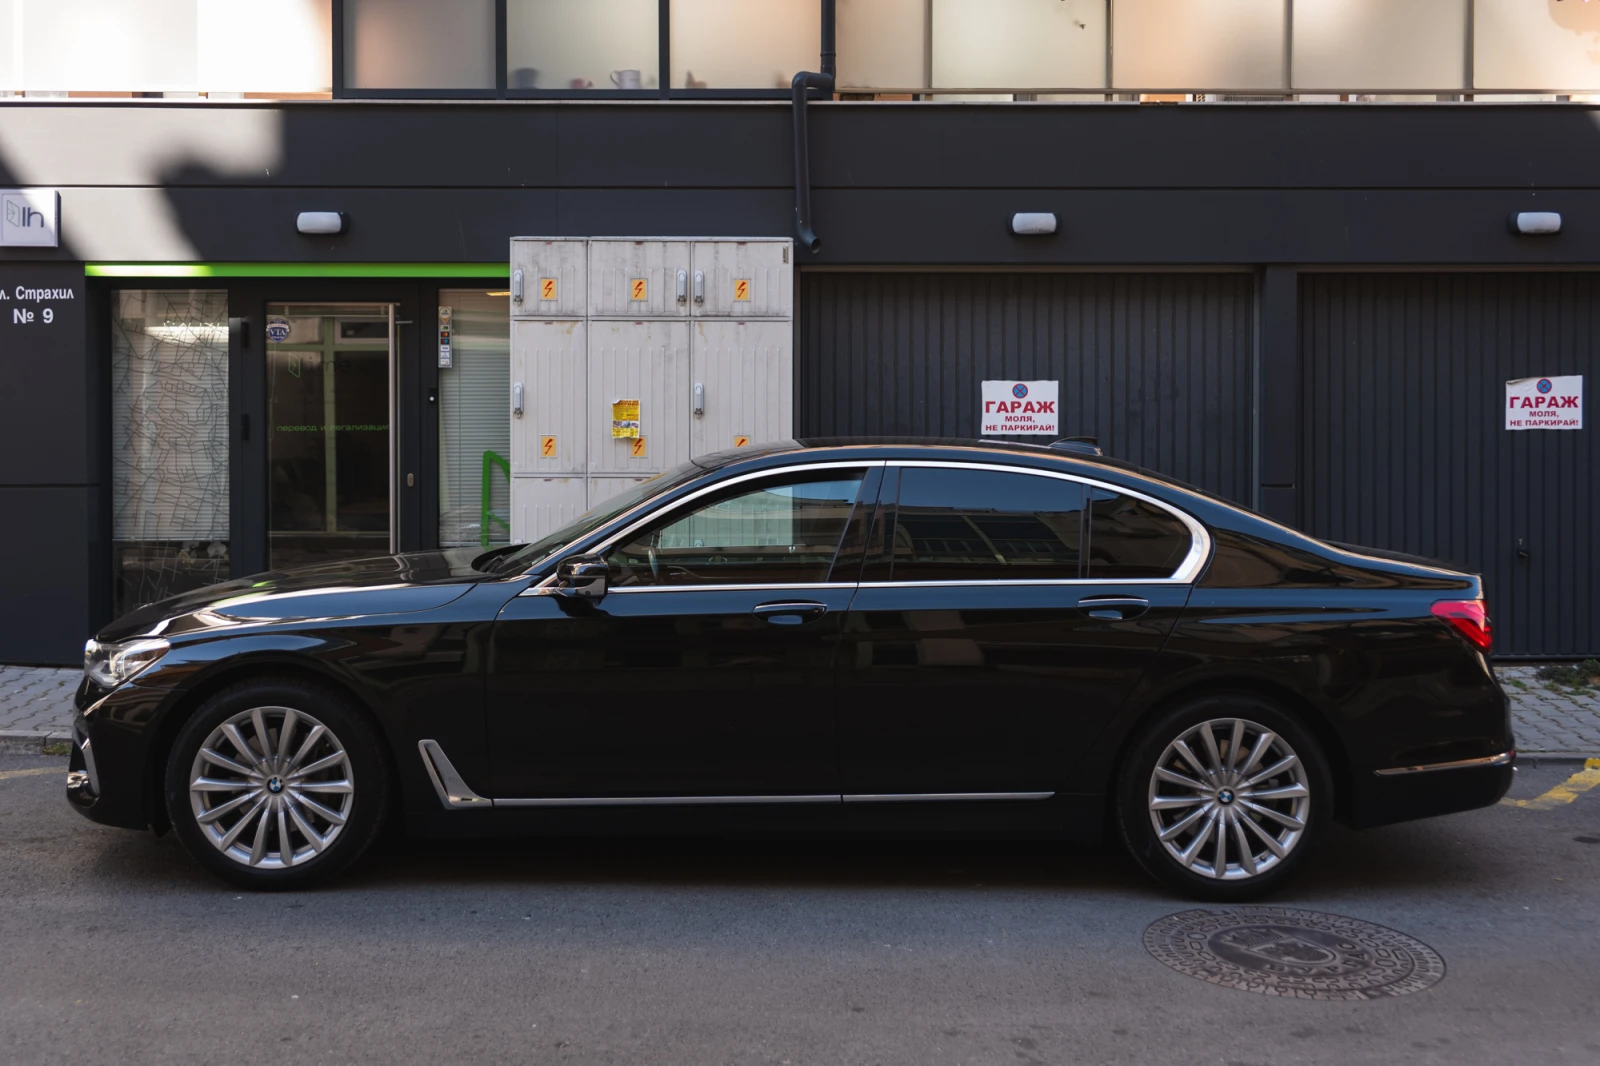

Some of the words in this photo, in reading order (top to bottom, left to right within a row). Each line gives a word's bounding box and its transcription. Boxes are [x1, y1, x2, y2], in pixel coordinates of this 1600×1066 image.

[0, 289, 10, 300] л.
[15, 286, 74, 303] Страхил
[42, 308, 54, 324] 9
[985, 401, 1055, 413] ГАРАЖ
[1509, 396, 1579, 409] ГАРАЖ
[1005, 415, 1035, 423] МОЛЯ,
[1529, 410, 1559, 418] МОЛЯ,
[1509, 419, 1523, 427] НЕ
[1525, 418, 1579, 427] ПАРКИРАЙ!
